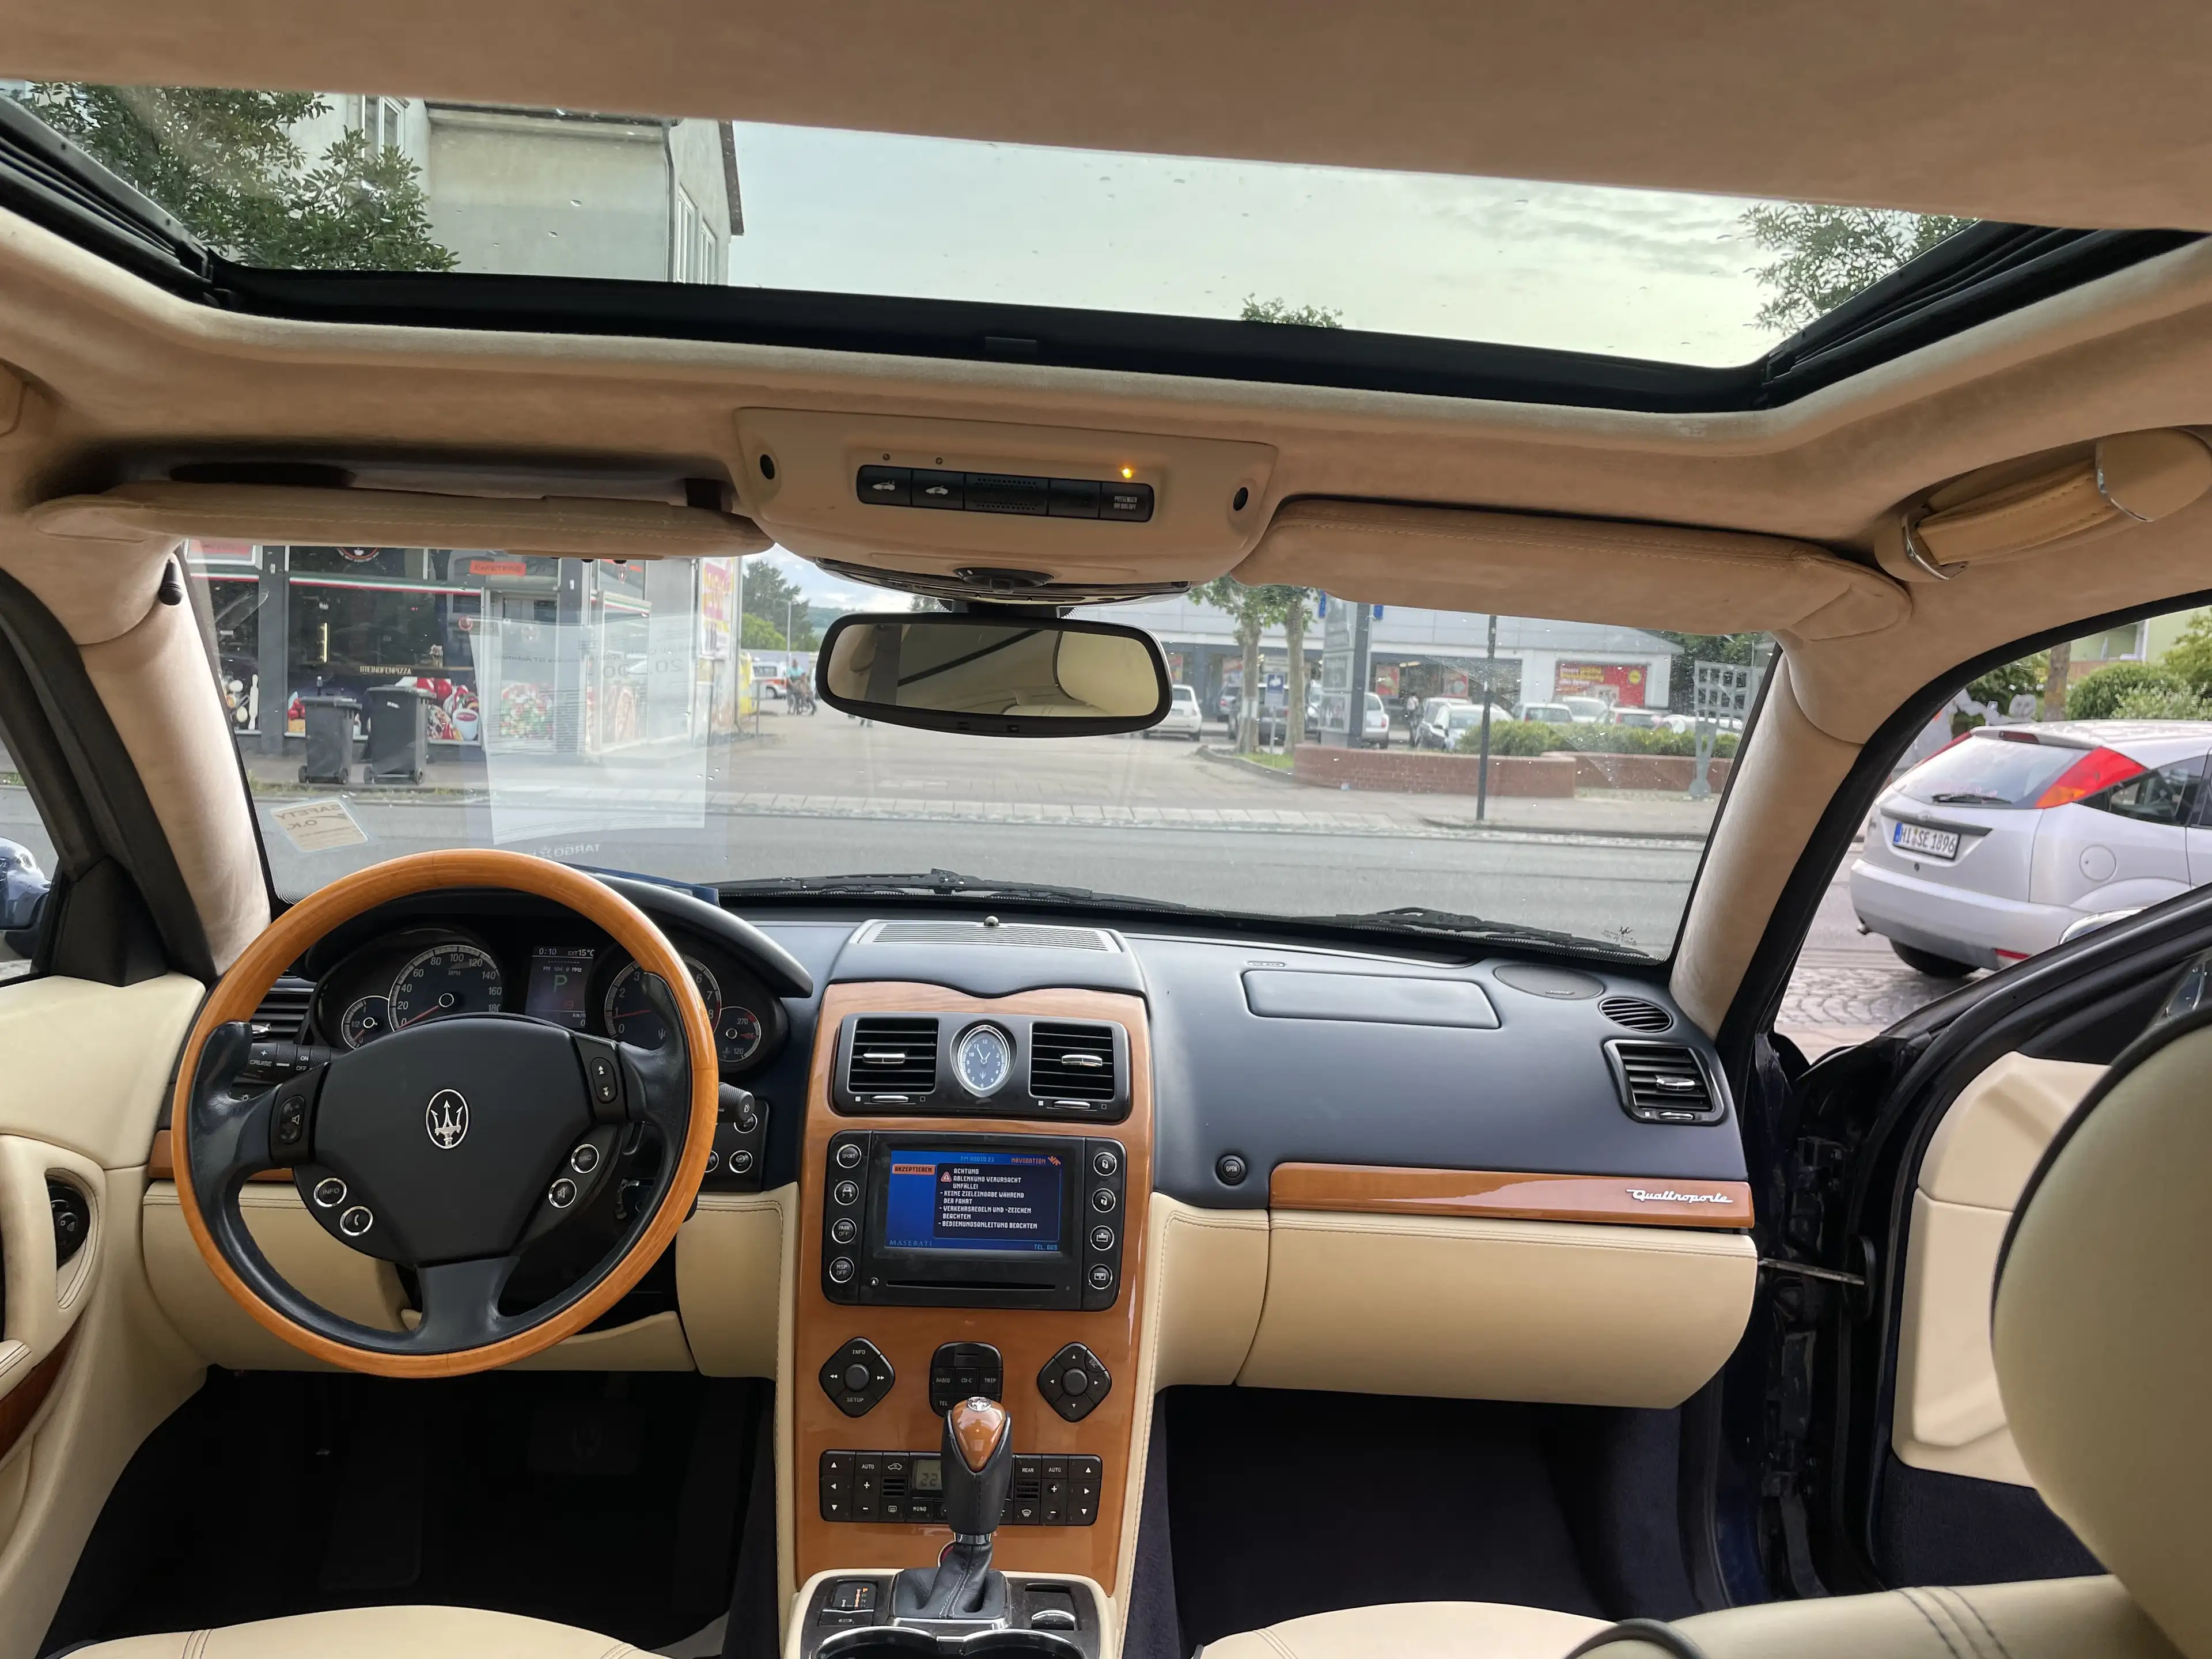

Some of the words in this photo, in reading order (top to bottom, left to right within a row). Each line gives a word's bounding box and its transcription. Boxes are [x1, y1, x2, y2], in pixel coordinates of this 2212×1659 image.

[1917, 830, 1930, 849] SE
[1931, 833, 1955, 853] 1896
[430, 957, 441, 965] 80
[450, 953, 464, 962] 100
[469, 959, 483, 967] 120
[413, 969, 424, 978] 60
[482, 971, 495, 980] 140
[634, 971, 640, 981] 3
[696, 974, 702, 983] 6
[401, 984, 412, 993] 40
[554, 975, 567, 993] P
[488, 986, 502, 995] 160
[619, 988, 626, 997] 2
[707, 991, 713, 1000] 7
[397, 1001, 408, 1010] 20
[619, 1024, 625, 1033] 0
[578, 1154, 592, 1162] SRC
[1626, 1189, 1734, 1203] Quattroporte
[1089, 1359, 1098, 1368] ESC
[920, 1472, 938, 1487] 22
